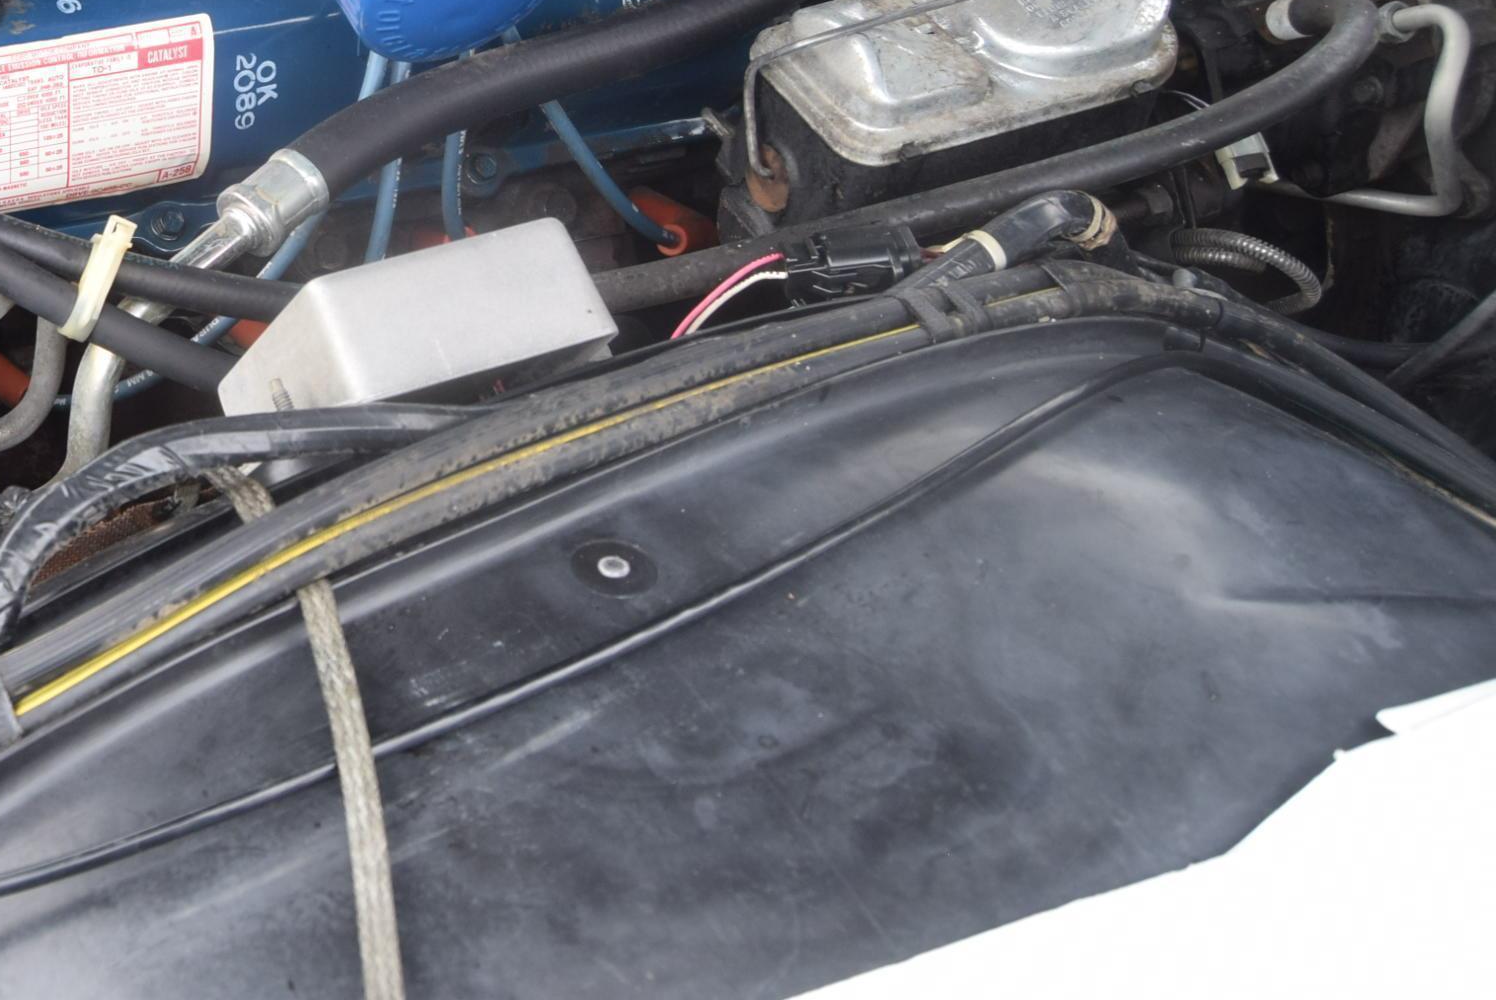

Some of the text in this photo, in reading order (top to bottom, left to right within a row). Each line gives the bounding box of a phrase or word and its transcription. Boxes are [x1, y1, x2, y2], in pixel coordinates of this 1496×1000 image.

[147, 44, 188, 64] CATALYST
[233, 52, 257, 131] 2089
[256, 60, 279, 107] OK
